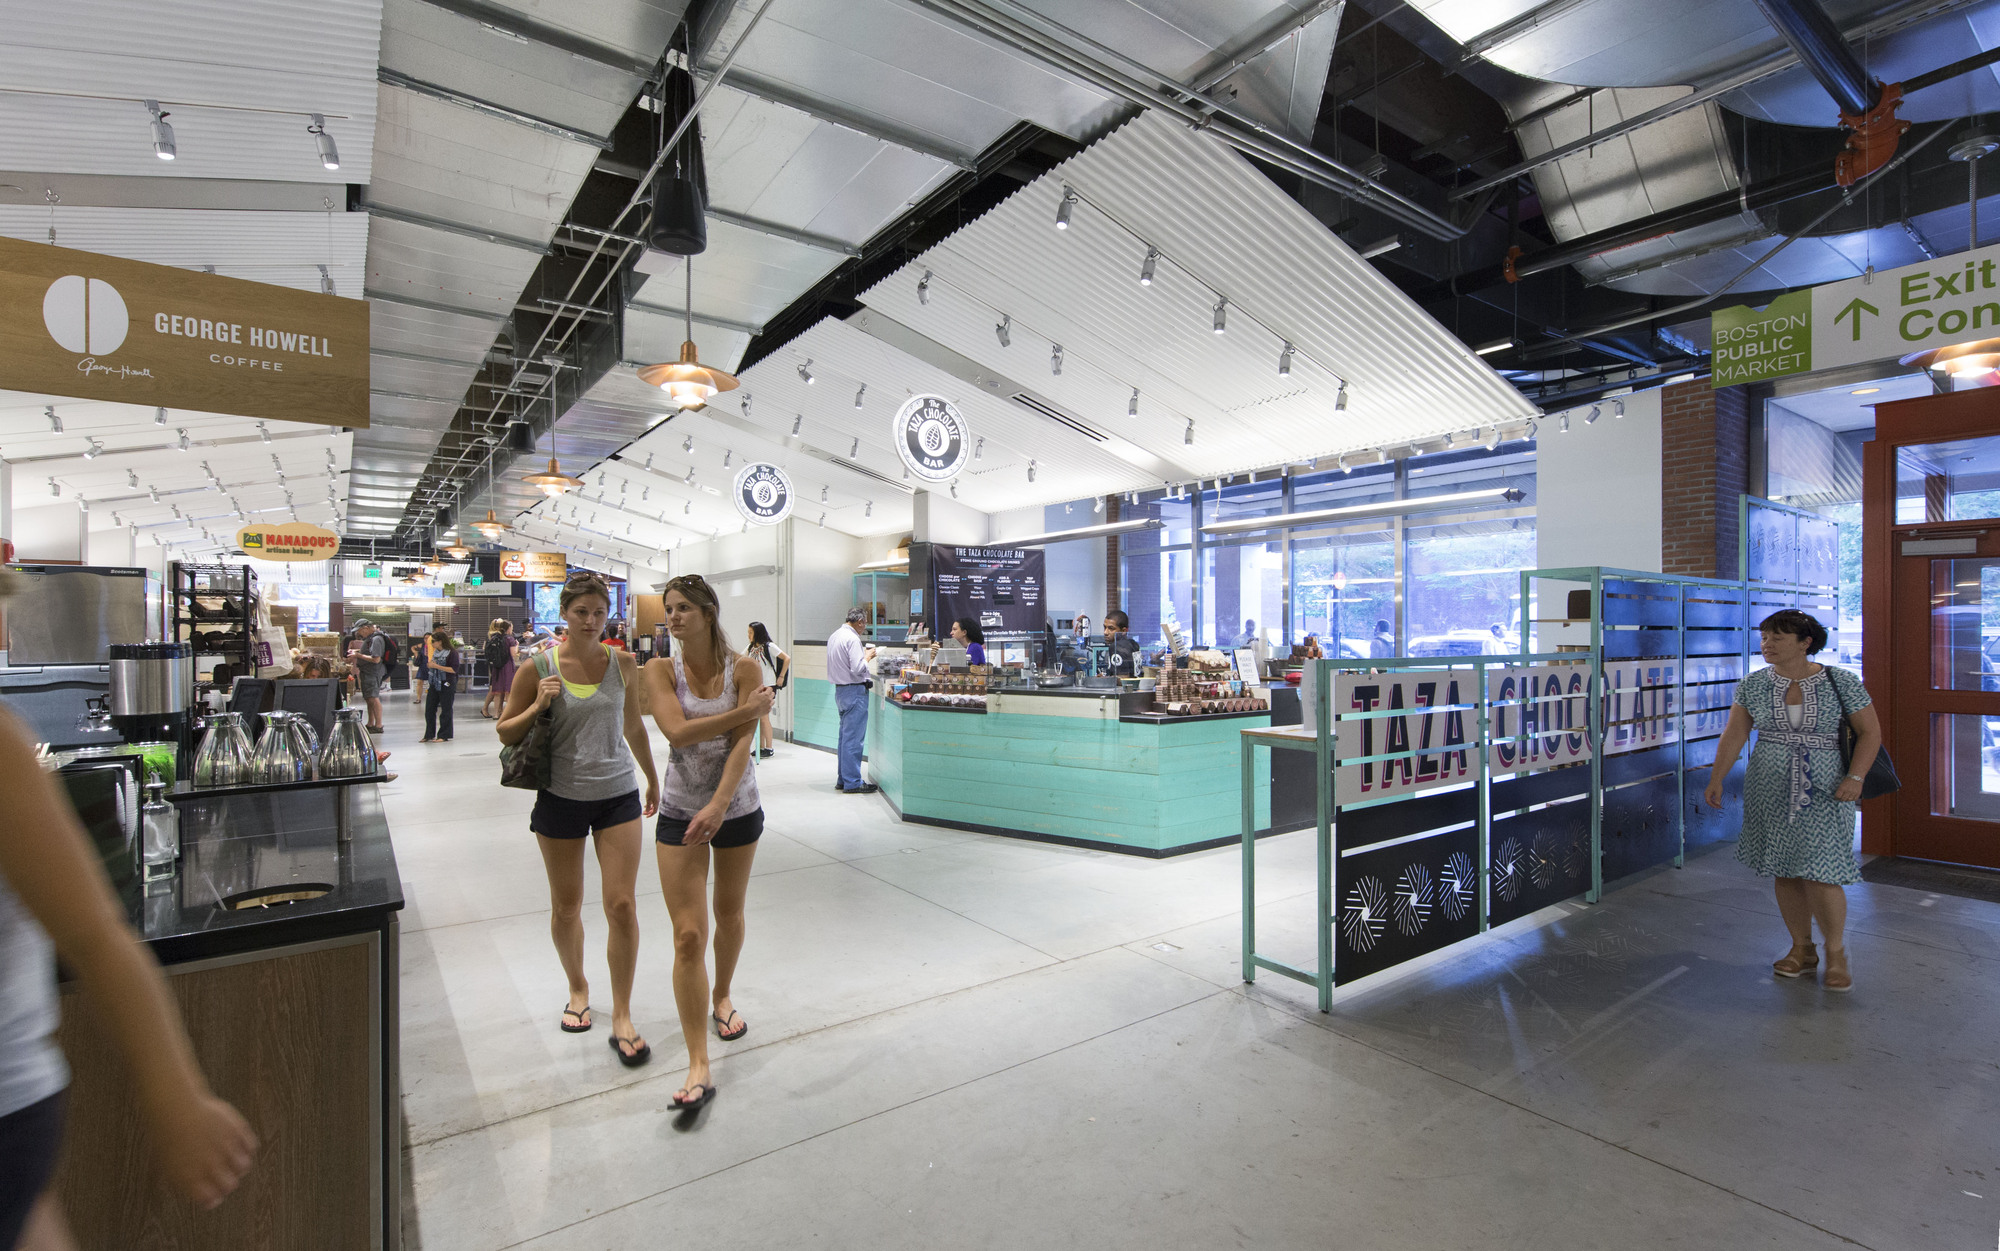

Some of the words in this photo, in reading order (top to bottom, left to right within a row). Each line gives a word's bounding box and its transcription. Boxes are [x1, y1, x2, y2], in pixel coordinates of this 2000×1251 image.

[1900, 258, 1997, 307] Exit
[1716, 313, 1806, 346] BOSTON
[1899, 302, 2000, 342] Con
[154, 312, 242, 345] GEORGE
[250, 326, 333, 358] HOWELL
[1716, 335, 1793, 363] PUBLIC
[209, 353, 284, 372] COFFEE
[1716, 352, 1806, 382] MARKET
[929, 400, 940, 408] The
[908, 413, 924, 433] TAZA
[923, 407, 960, 440] CHOCOLATE
[923, 457, 945, 467] BAR
[743, 476, 757, 491] TAZA
[756, 472, 786, 495] CHOCOLATE
[755, 507, 773, 515] BAR
[265, 534, 336, 548] MAMADOU'S
[292, 547, 314, 556] bakery
[955, 547, 967, 556] THE
[968, 548, 981, 557] TAZA
[982, 549, 1013, 558] CHOCOLATE
[366, 568, 379, 578] EXIT
[472, 577, 481, 585] EXIT
[1352, 680, 1468, 793] TAZA
[1495, 667, 1674, 768] CHOCOLATE
